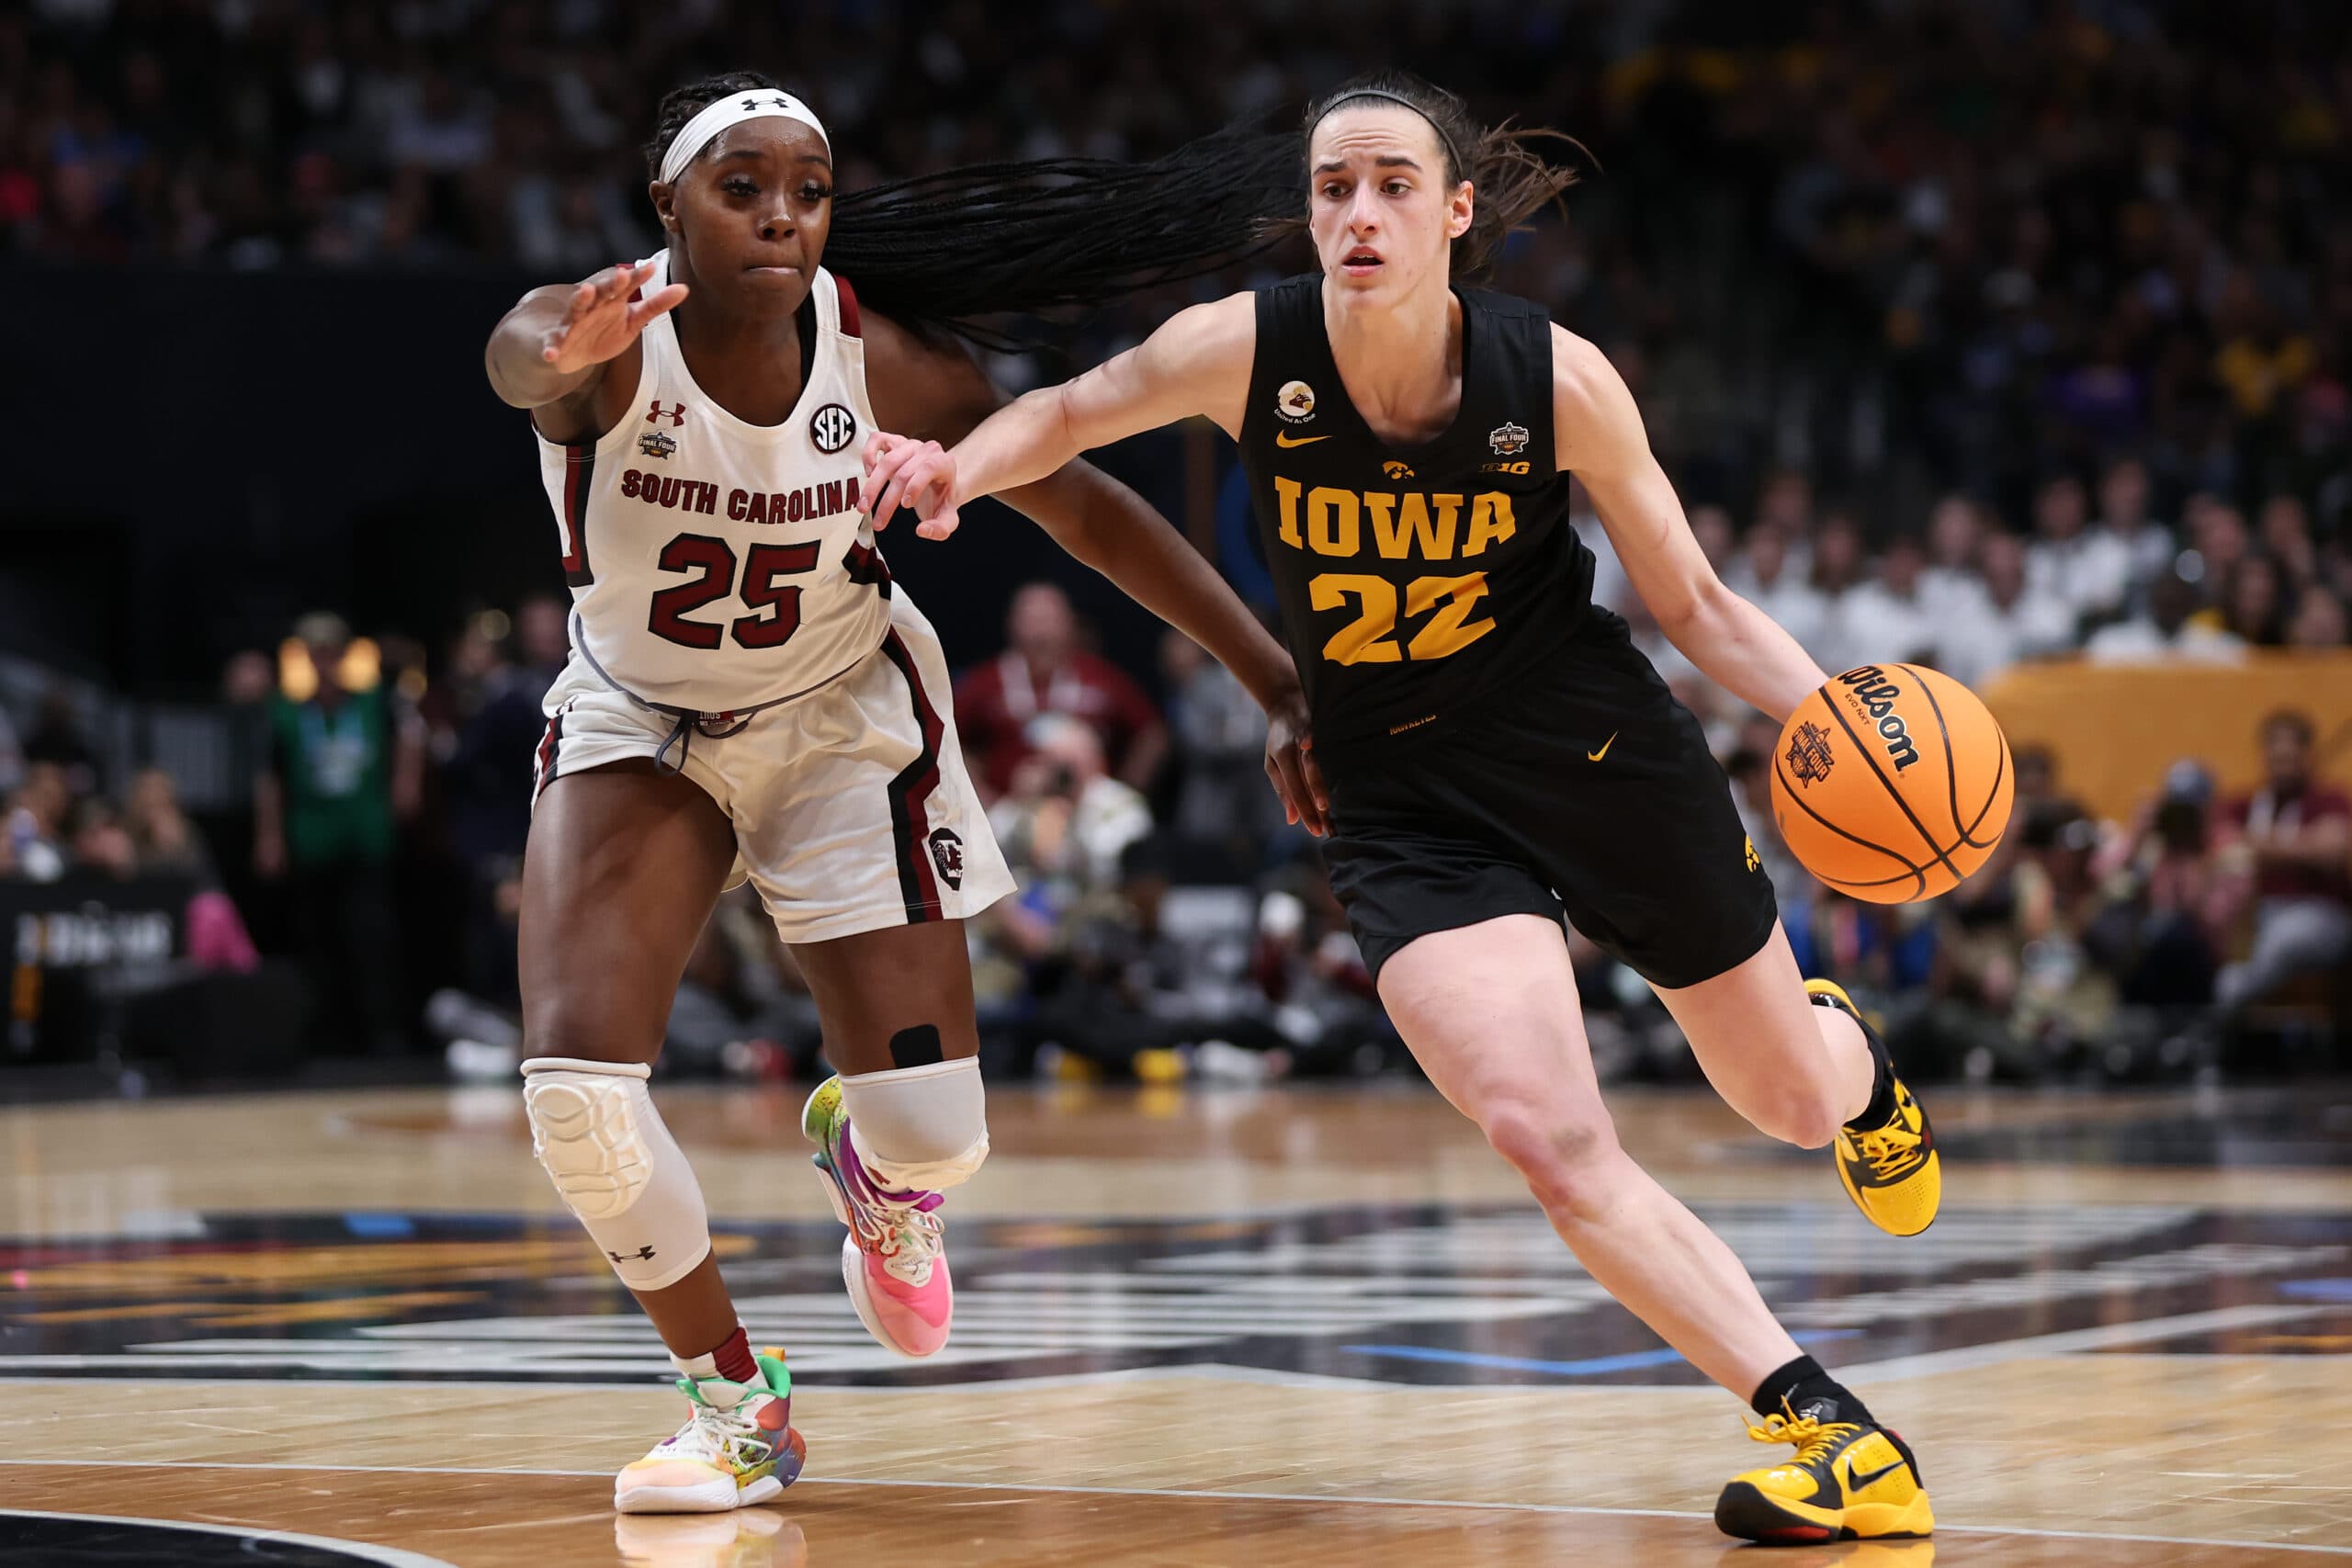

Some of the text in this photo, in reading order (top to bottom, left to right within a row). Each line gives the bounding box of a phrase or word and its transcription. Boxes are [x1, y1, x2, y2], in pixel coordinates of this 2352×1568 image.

[813, 407, 853, 450] SEC
[1274, 409, 1294, 423] United
[1303, 413, 1316, 423] One
[1491, 434, 1526, 445] FINAL FOUR
[658, 441, 675, 451] FOUR
[621, 468, 861, 525] SOUTH CAROLINA
[1274, 476, 1516, 560] IOWA
[647, 532, 822, 649] 25
[1308, 570, 1498, 667] 22
[1838, 665, 1918, 772] Wilson
[1845, 693, 1871, 726] EVO NXT
[1793, 727, 1828, 781] FINAL FOUR
